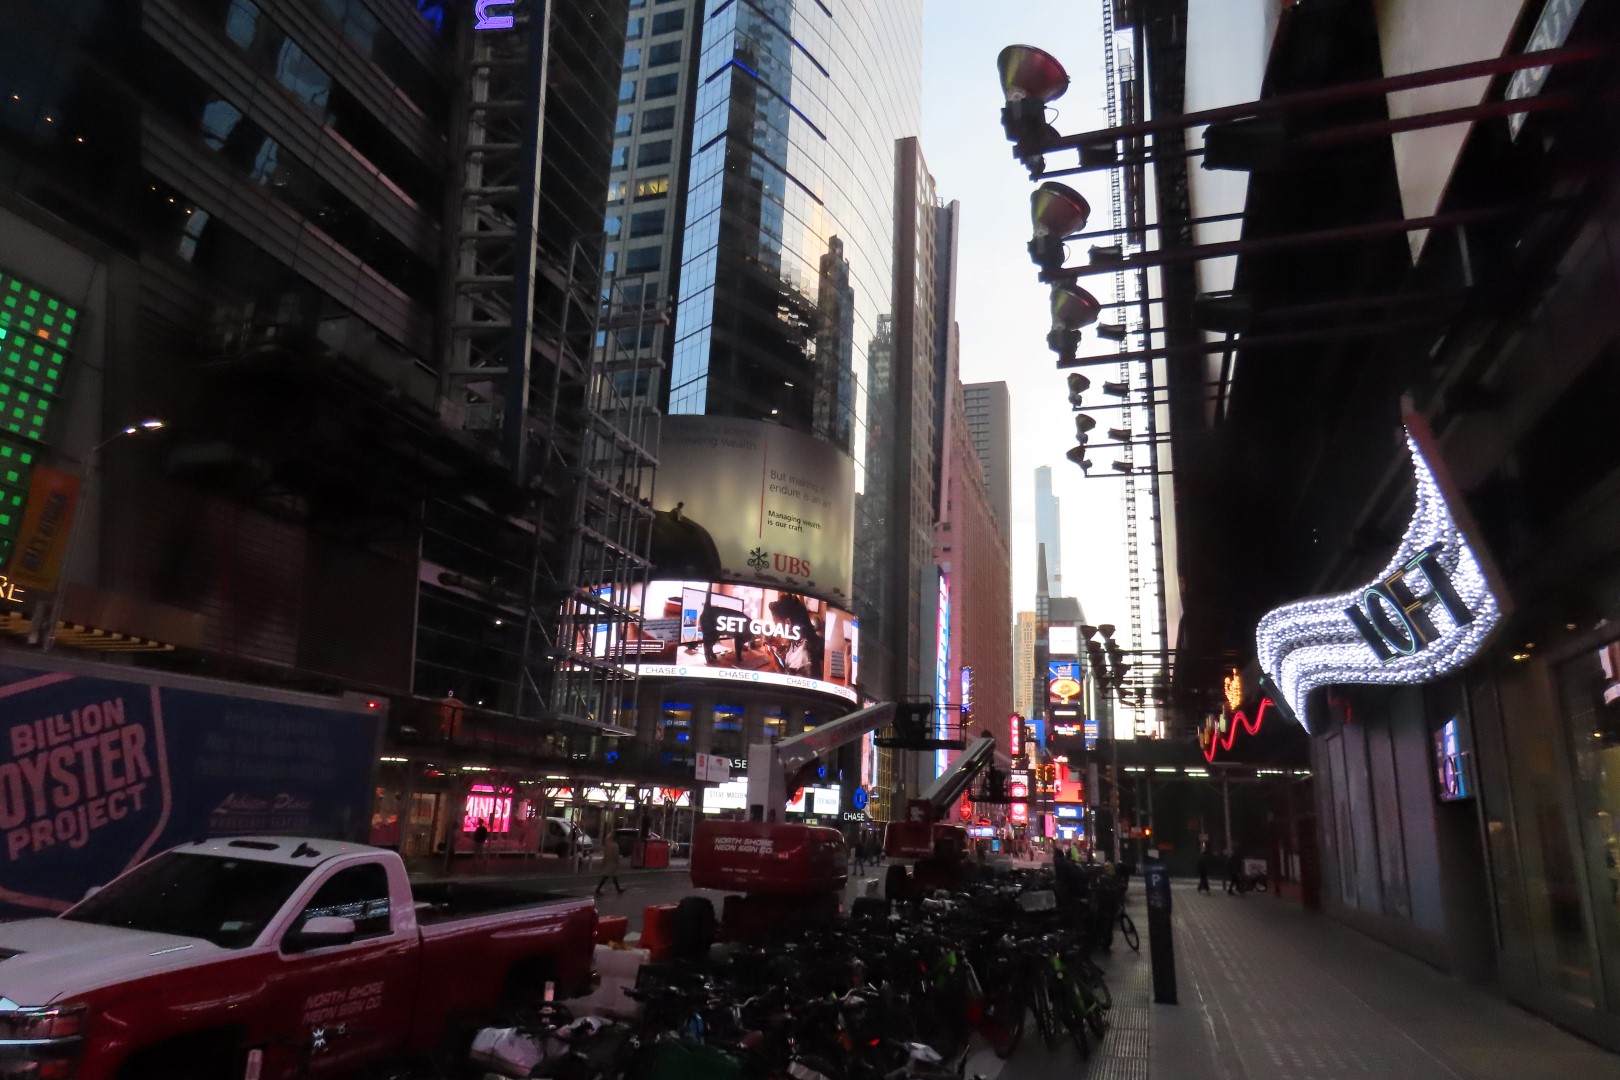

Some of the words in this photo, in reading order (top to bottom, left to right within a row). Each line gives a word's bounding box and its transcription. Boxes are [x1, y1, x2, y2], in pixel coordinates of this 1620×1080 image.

[769, 484, 801, 498] endure
[770, 469, 786, 482] But
[789, 475, 817, 493] making
[767, 518, 774, 526] is
[775, 521, 787, 529] our
[768, 510, 801, 524] Managing
[802, 519, 822, 530] wealth
[774, 553, 811, 578] UBS
[1343, 541, 1476, 665] LOFT
[716, 615, 747, 633] SET
[749, 618, 801, 641] GOALS
[645, 666, 677, 675] CHASE
[718, 670, 750, 680] CHASE
[786, 677, 811, 688] CHASE
[10, 697, 126, 757] BILLION
[0, 723, 152, 829] OYSTER
[466, 795, 511, 819] MINISO
[843, 812, 865, 822] CHASE
[7, 783, 147, 861] PROJECT
[714, 837, 743, 845] NORTH
[744, 838, 774, 847] SHORE
[714, 844, 737, 852] NEON
[738, 845, 759, 853] SIGN
[1151, 873, 1161, 887] P
[304, 991, 346, 1010] NORTH
[348, 981, 385, 999] SHORE
[302, 1006, 338, 1024] NEON
